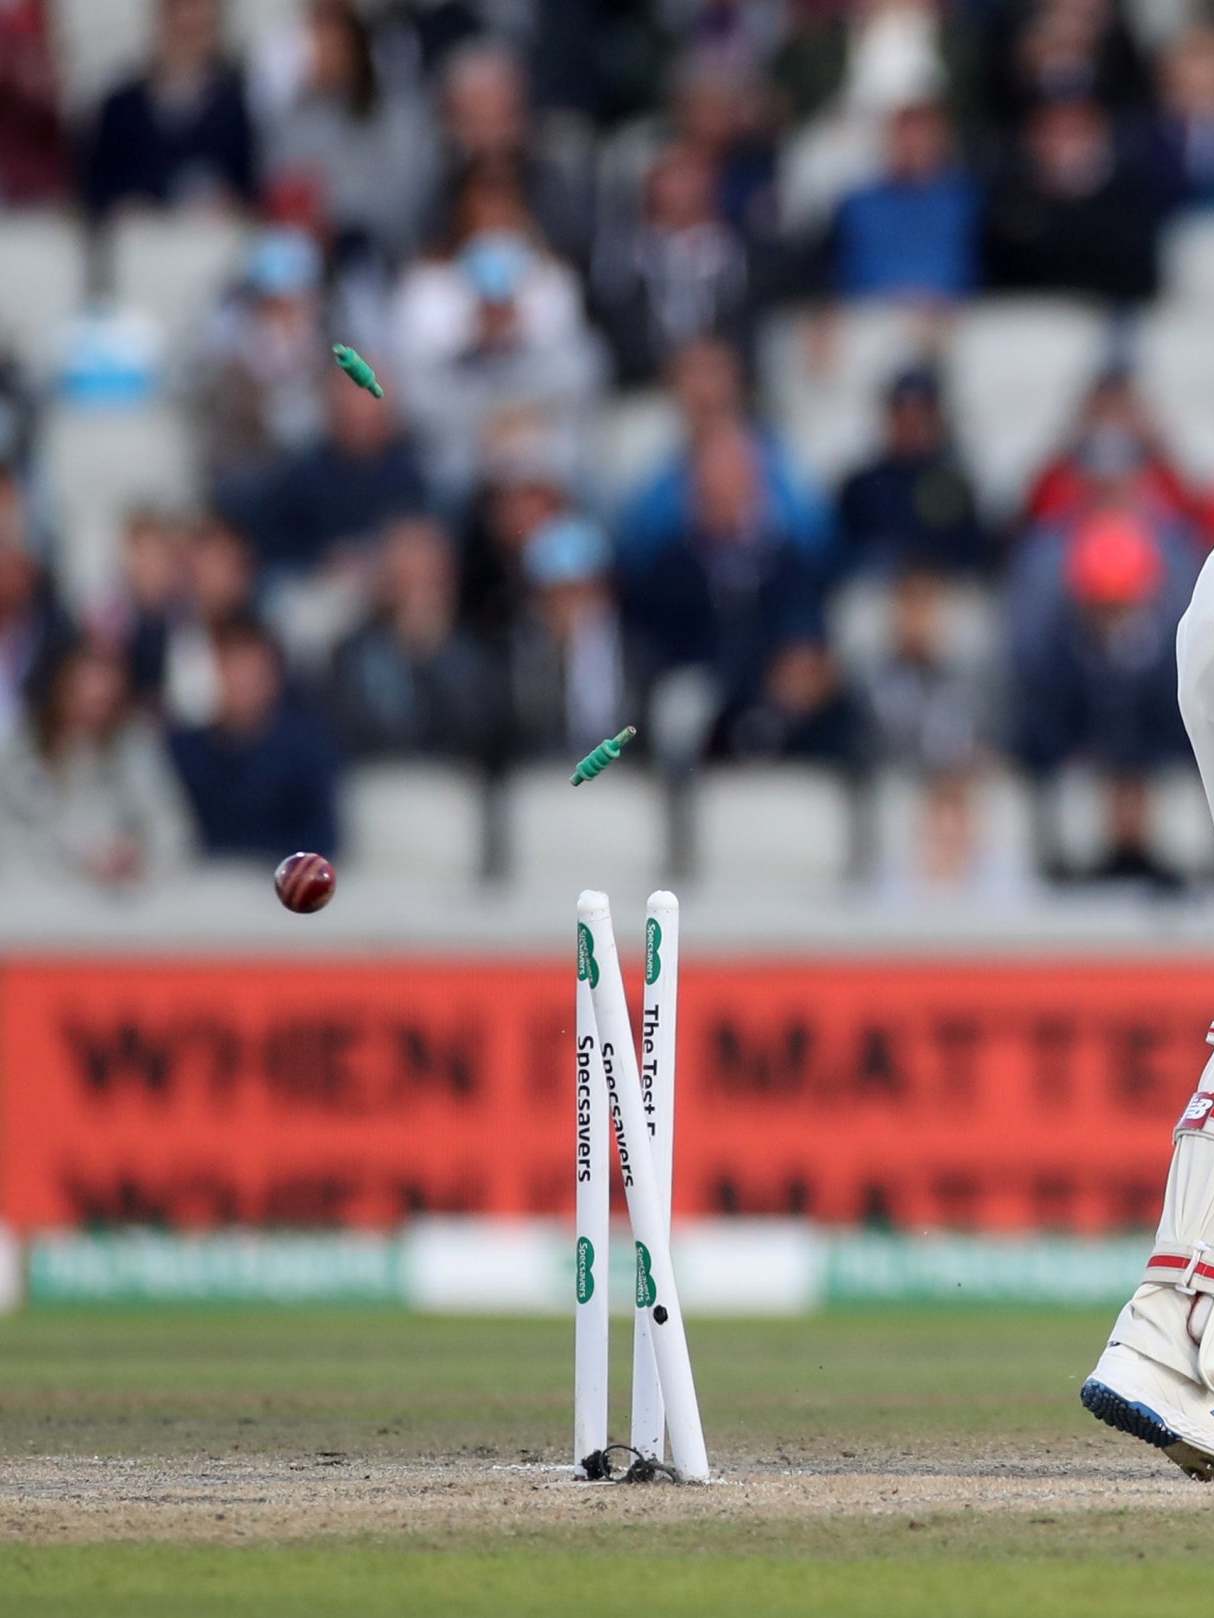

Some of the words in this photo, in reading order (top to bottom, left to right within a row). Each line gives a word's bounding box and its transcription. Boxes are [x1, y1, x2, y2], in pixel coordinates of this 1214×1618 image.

[647, 923, 656, 980] Specsavers
[643, 1004, 659, 1054] The
[702, 1008, 1208, 1110] MATTE
[577, 1035, 594, 1182] Specsavers
[579, 1242, 588, 1298] Specsavers
